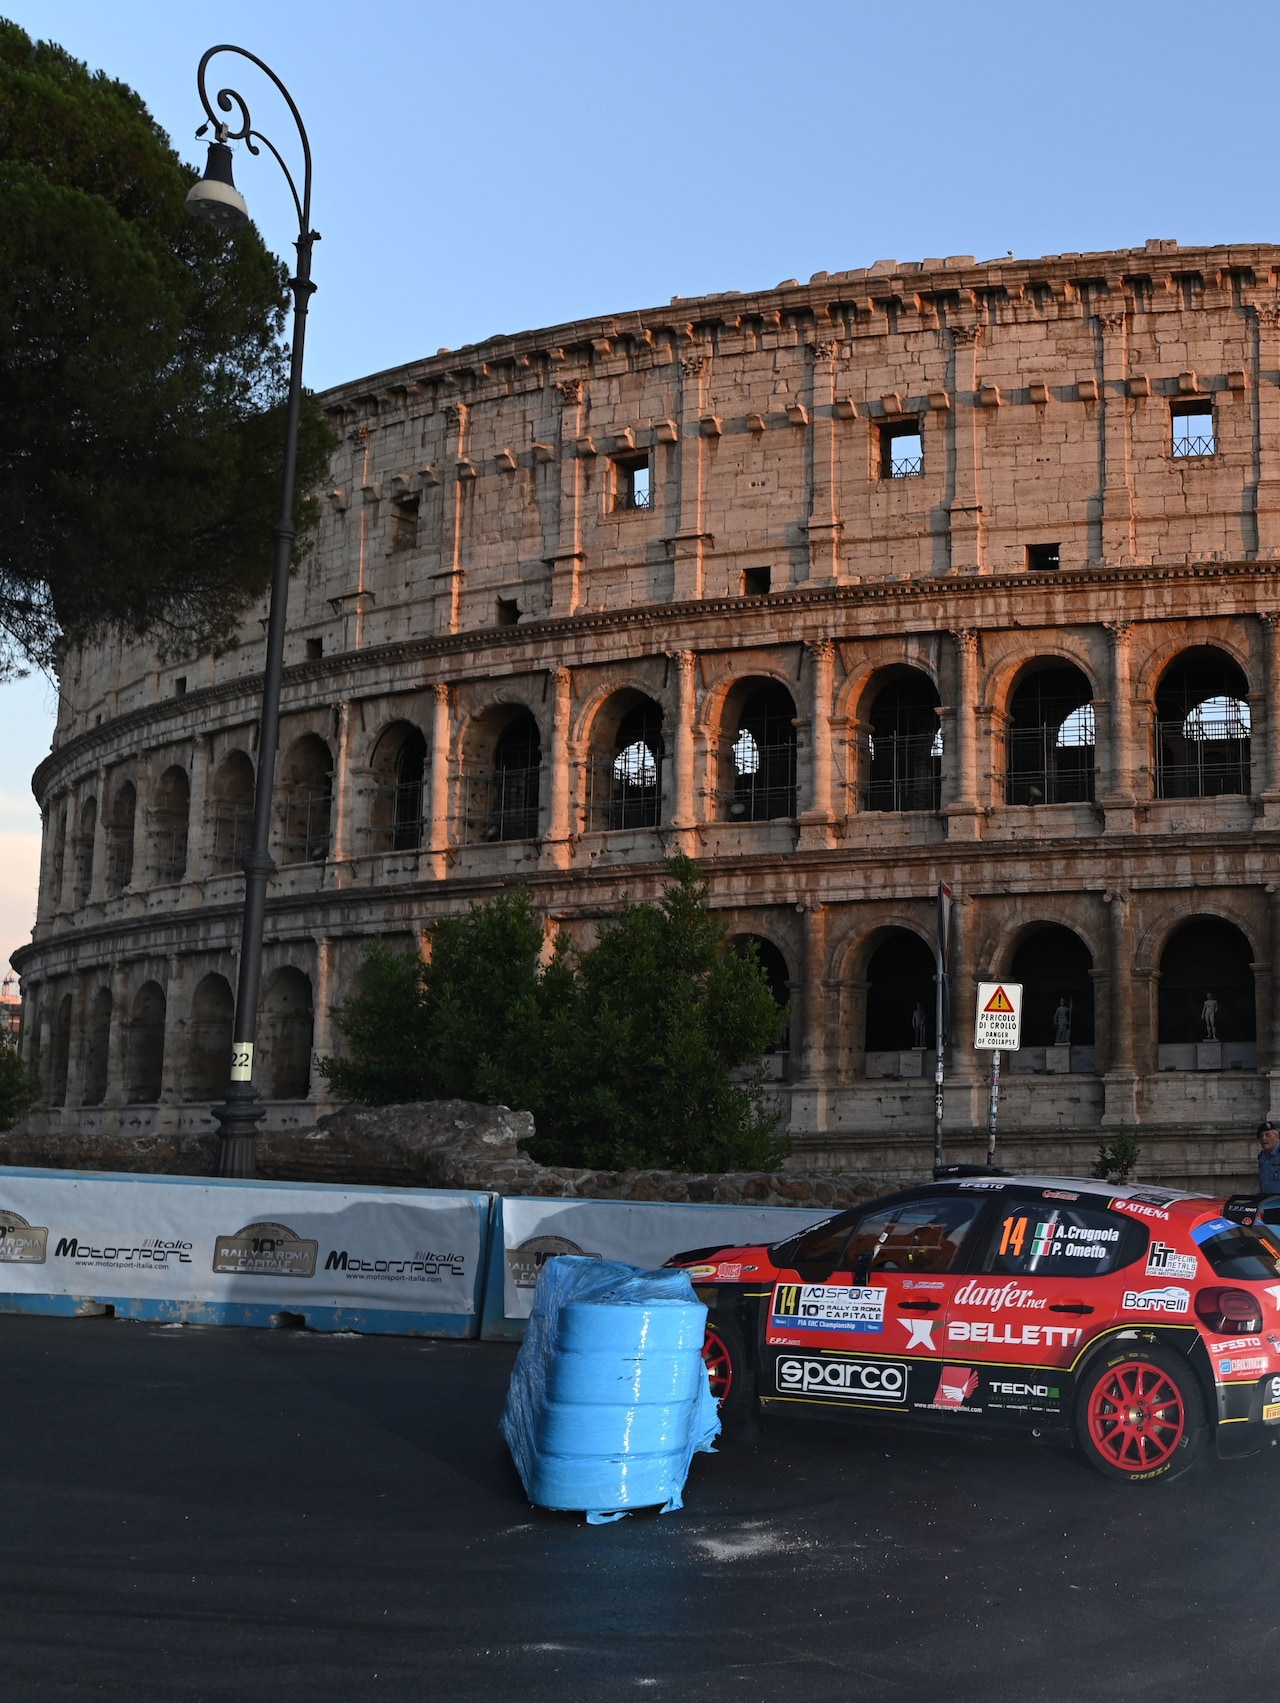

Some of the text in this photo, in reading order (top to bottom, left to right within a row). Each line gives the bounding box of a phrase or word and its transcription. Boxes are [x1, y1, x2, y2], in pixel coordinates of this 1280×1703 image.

[980, 1014, 1016, 1022] PERICOLO
[1126, 1202, 1170, 1220] ATHENA
[998, 1216, 1028, 1256] 14
[1056, 1226, 1120, 1242] A.Crugnola
[7, 1239, 40, 1248] ROMA
[154, 1239, 192, 1250] Italia
[55, 1238, 192, 1263] Motorsport
[221, 1248, 259, 1258] RALLY
[276, 1252, 311, 1260] ROMA
[1052, 1242, 1106, 1258] P. Ometto
[324, 1250, 465, 1276] Motorsport
[426, 1252, 465, 1262] Italia
[1168, 1254, 1196, 1263] SPECIAL
[75, 1260, 169, 1270] www.motorsport-italia.com
[1167, 1262, 1196, 1271] METALS
[346, 1273, 442, 1283] www.motorsport-italia.com
[780, 1286, 797, 1315] 14
[826, 1288, 885, 1301] SPORT
[826, 1311, 882, 1320] CAPITALE
[820, 1321, 856, 1330] Championship
[947, 1321, 1082, 1348] BELLETTI
[1210, 1338, 1260, 1353] EFESTO
[781, 1361, 902, 1390] sparco
